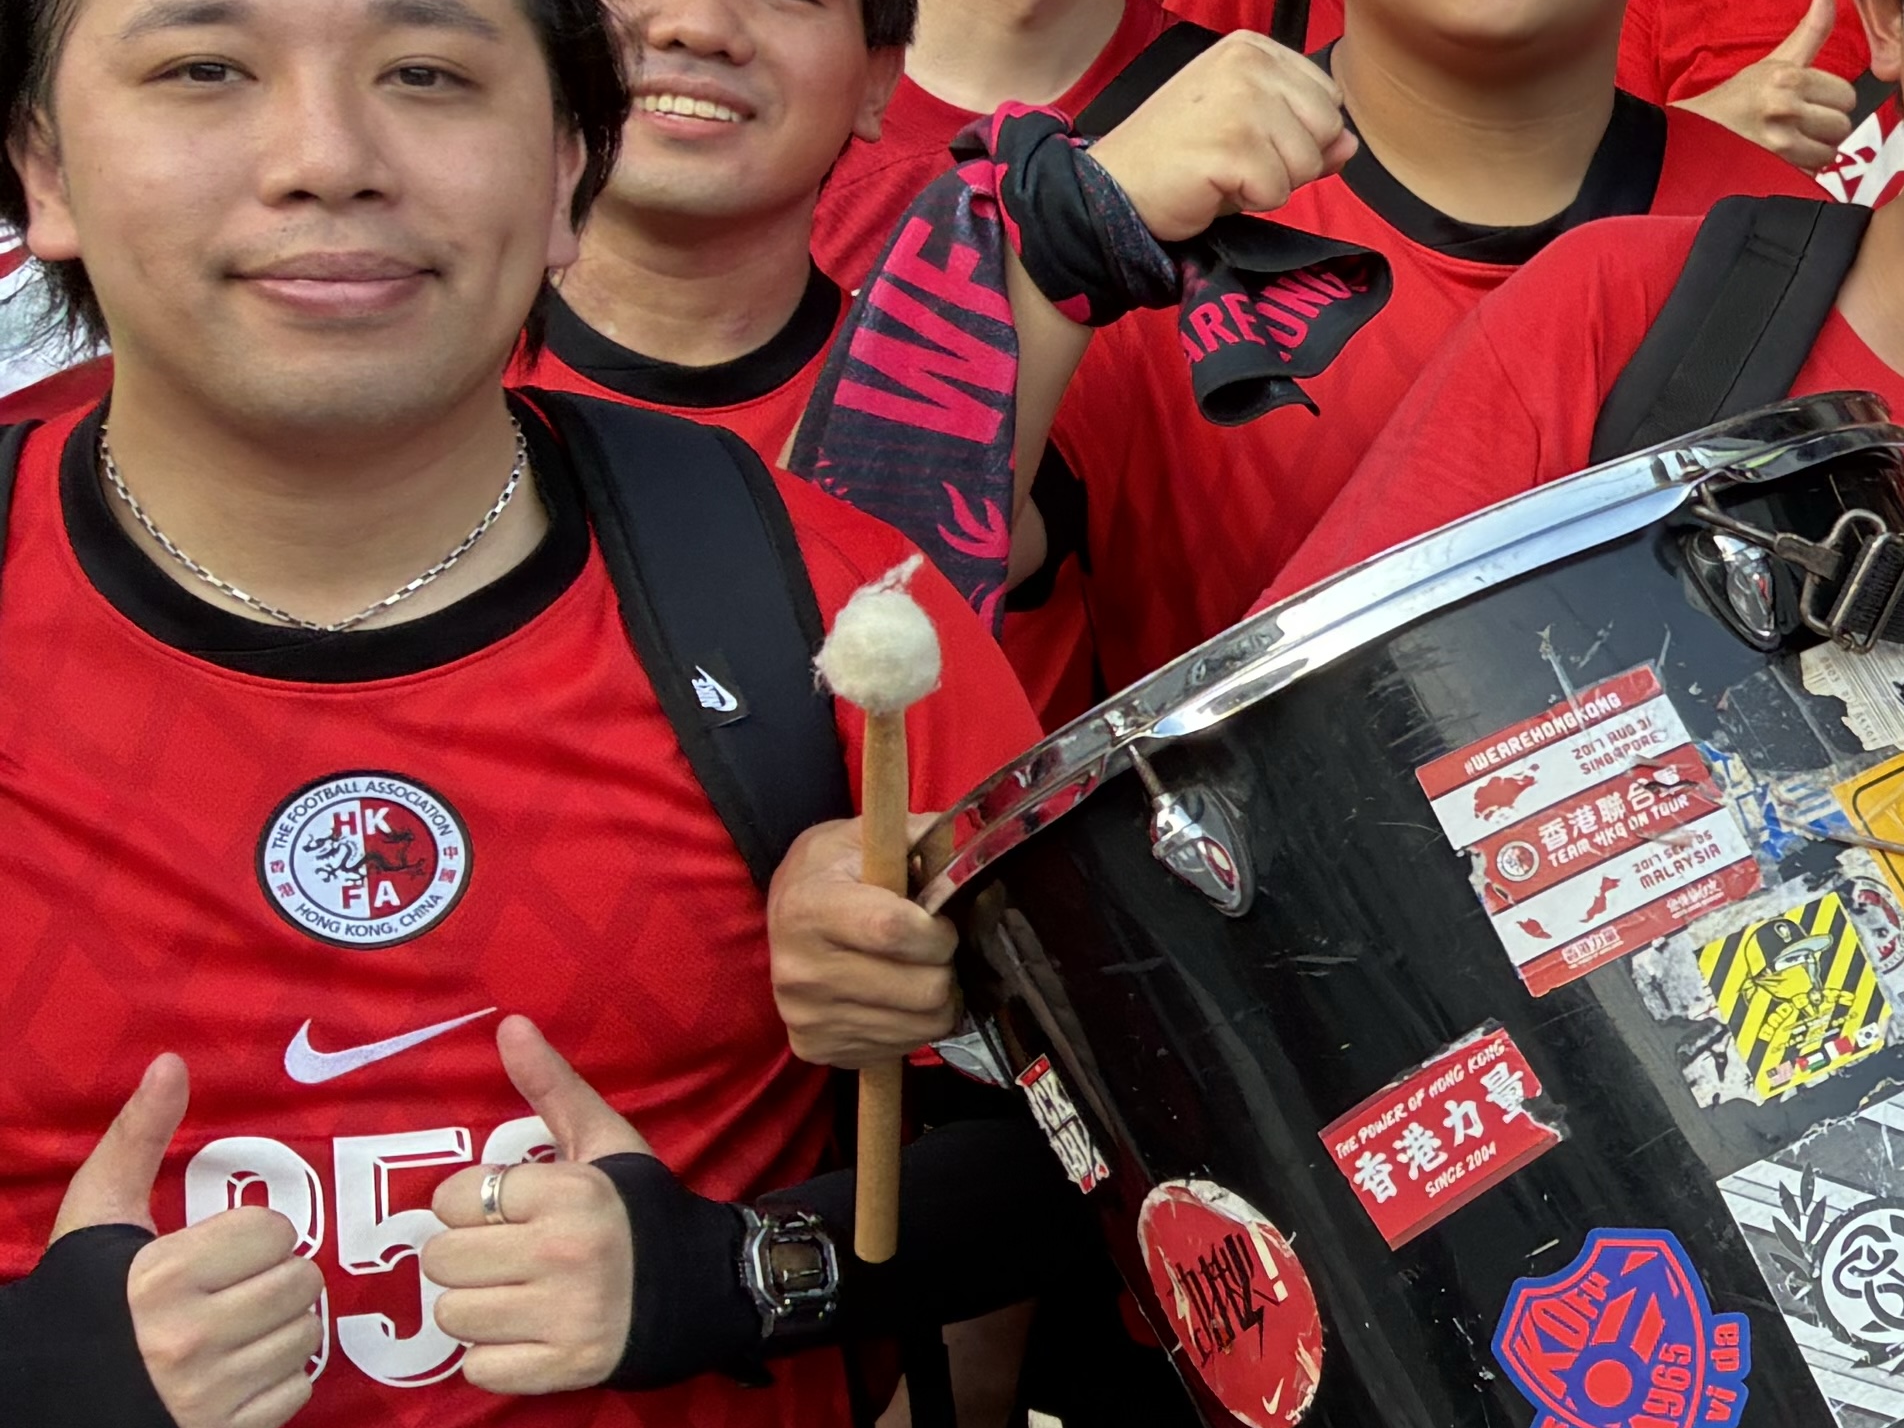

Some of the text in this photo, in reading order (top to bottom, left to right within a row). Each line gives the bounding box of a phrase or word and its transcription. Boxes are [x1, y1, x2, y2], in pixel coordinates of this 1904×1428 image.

[271, 780, 454, 851] THE FOOTBALL ASSOCIATION
[332, 806, 393, 837] HK
[1547, 838, 1592, 868] TEAM
[1628, 810, 1649, 833] ON
[1649, 795, 1691, 824] TOUR
[1639, 843, 1724, 891] MALAYSIA
[294, 902, 342, 935] HONG
[398, 892, 445, 928] CHINA
[341, 879, 402, 911] FA
[1757, 1001, 1795, 1045] BAD
[1334, 1038, 1507, 1161] THE POWER OF HONG KONG
[1352, 1060, 1527, 1204] 香港力量
[1424, 1142, 1498, 1199] SINCE 2004
[1711, 1321, 1742, 1373] da
[1704, 1384, 1738, 1423] vi
